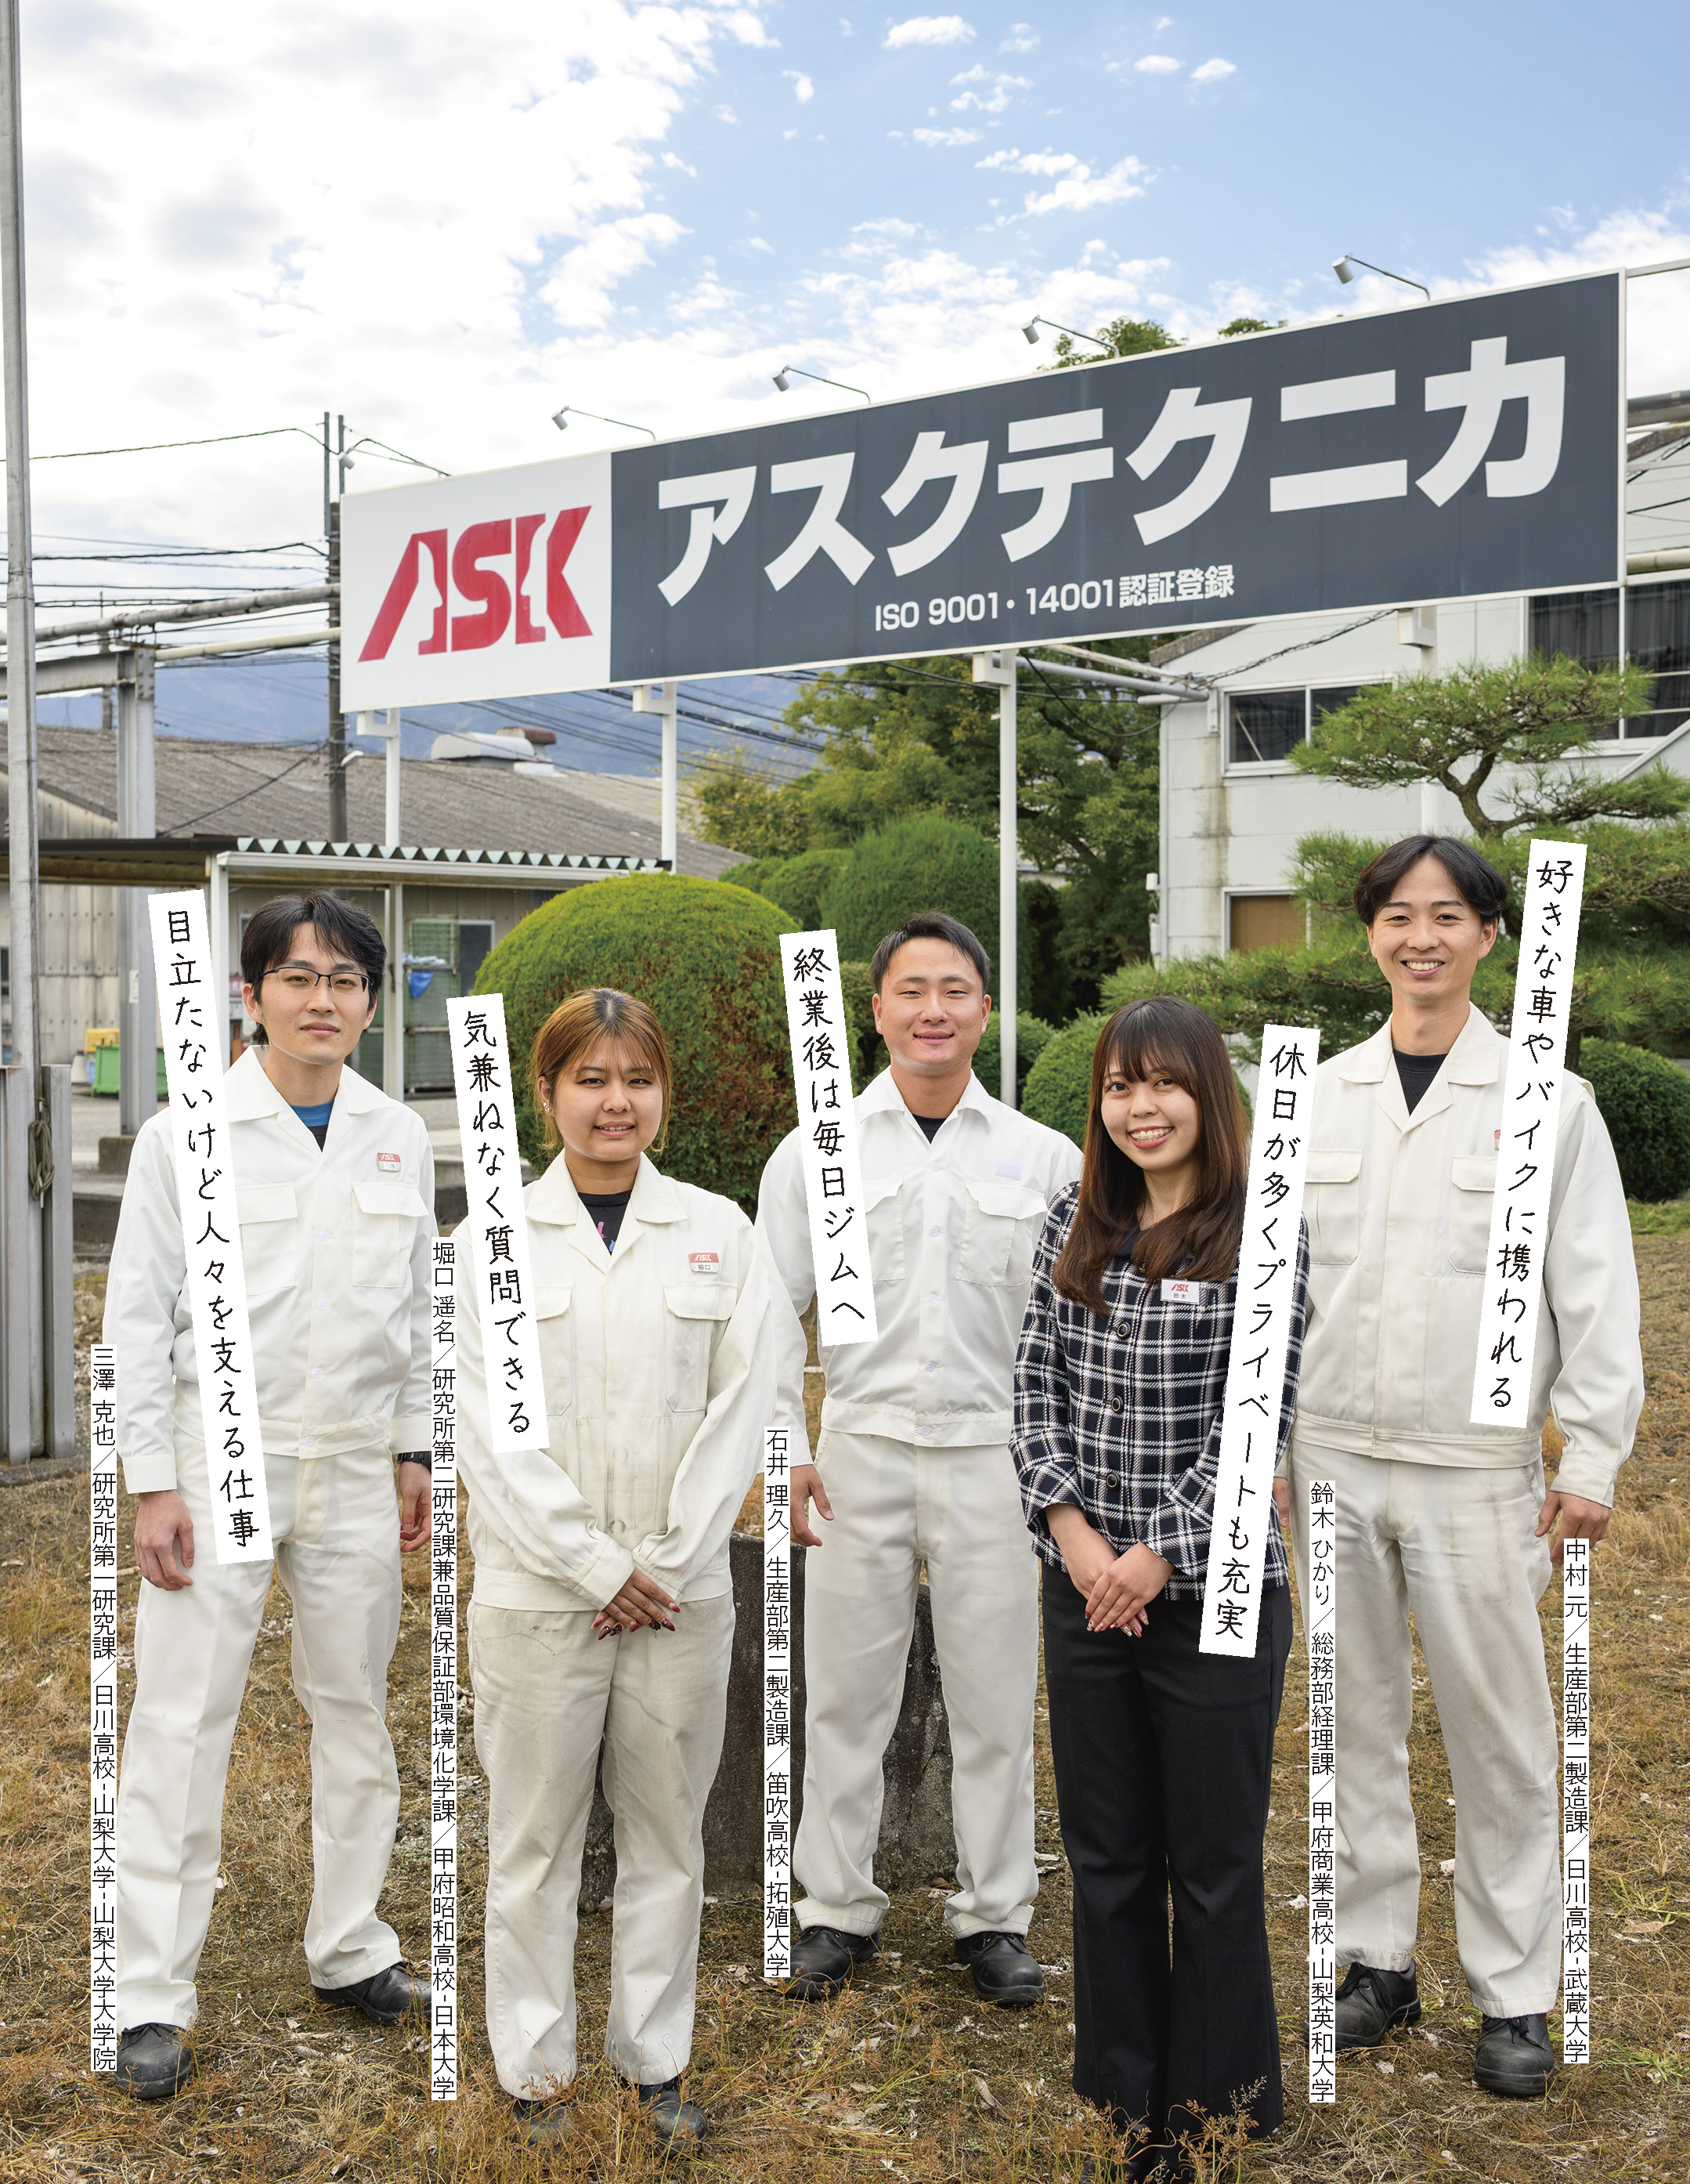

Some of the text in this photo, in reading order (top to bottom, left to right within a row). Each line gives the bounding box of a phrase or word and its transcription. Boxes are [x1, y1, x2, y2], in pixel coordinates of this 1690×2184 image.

[657, 336, 1565, 607] アスクテクニカ
[358, 505, 593, 662] ASK
[876, 601, 920, 631] ISO
[1171, 1283, 1190, 1293] ASK
